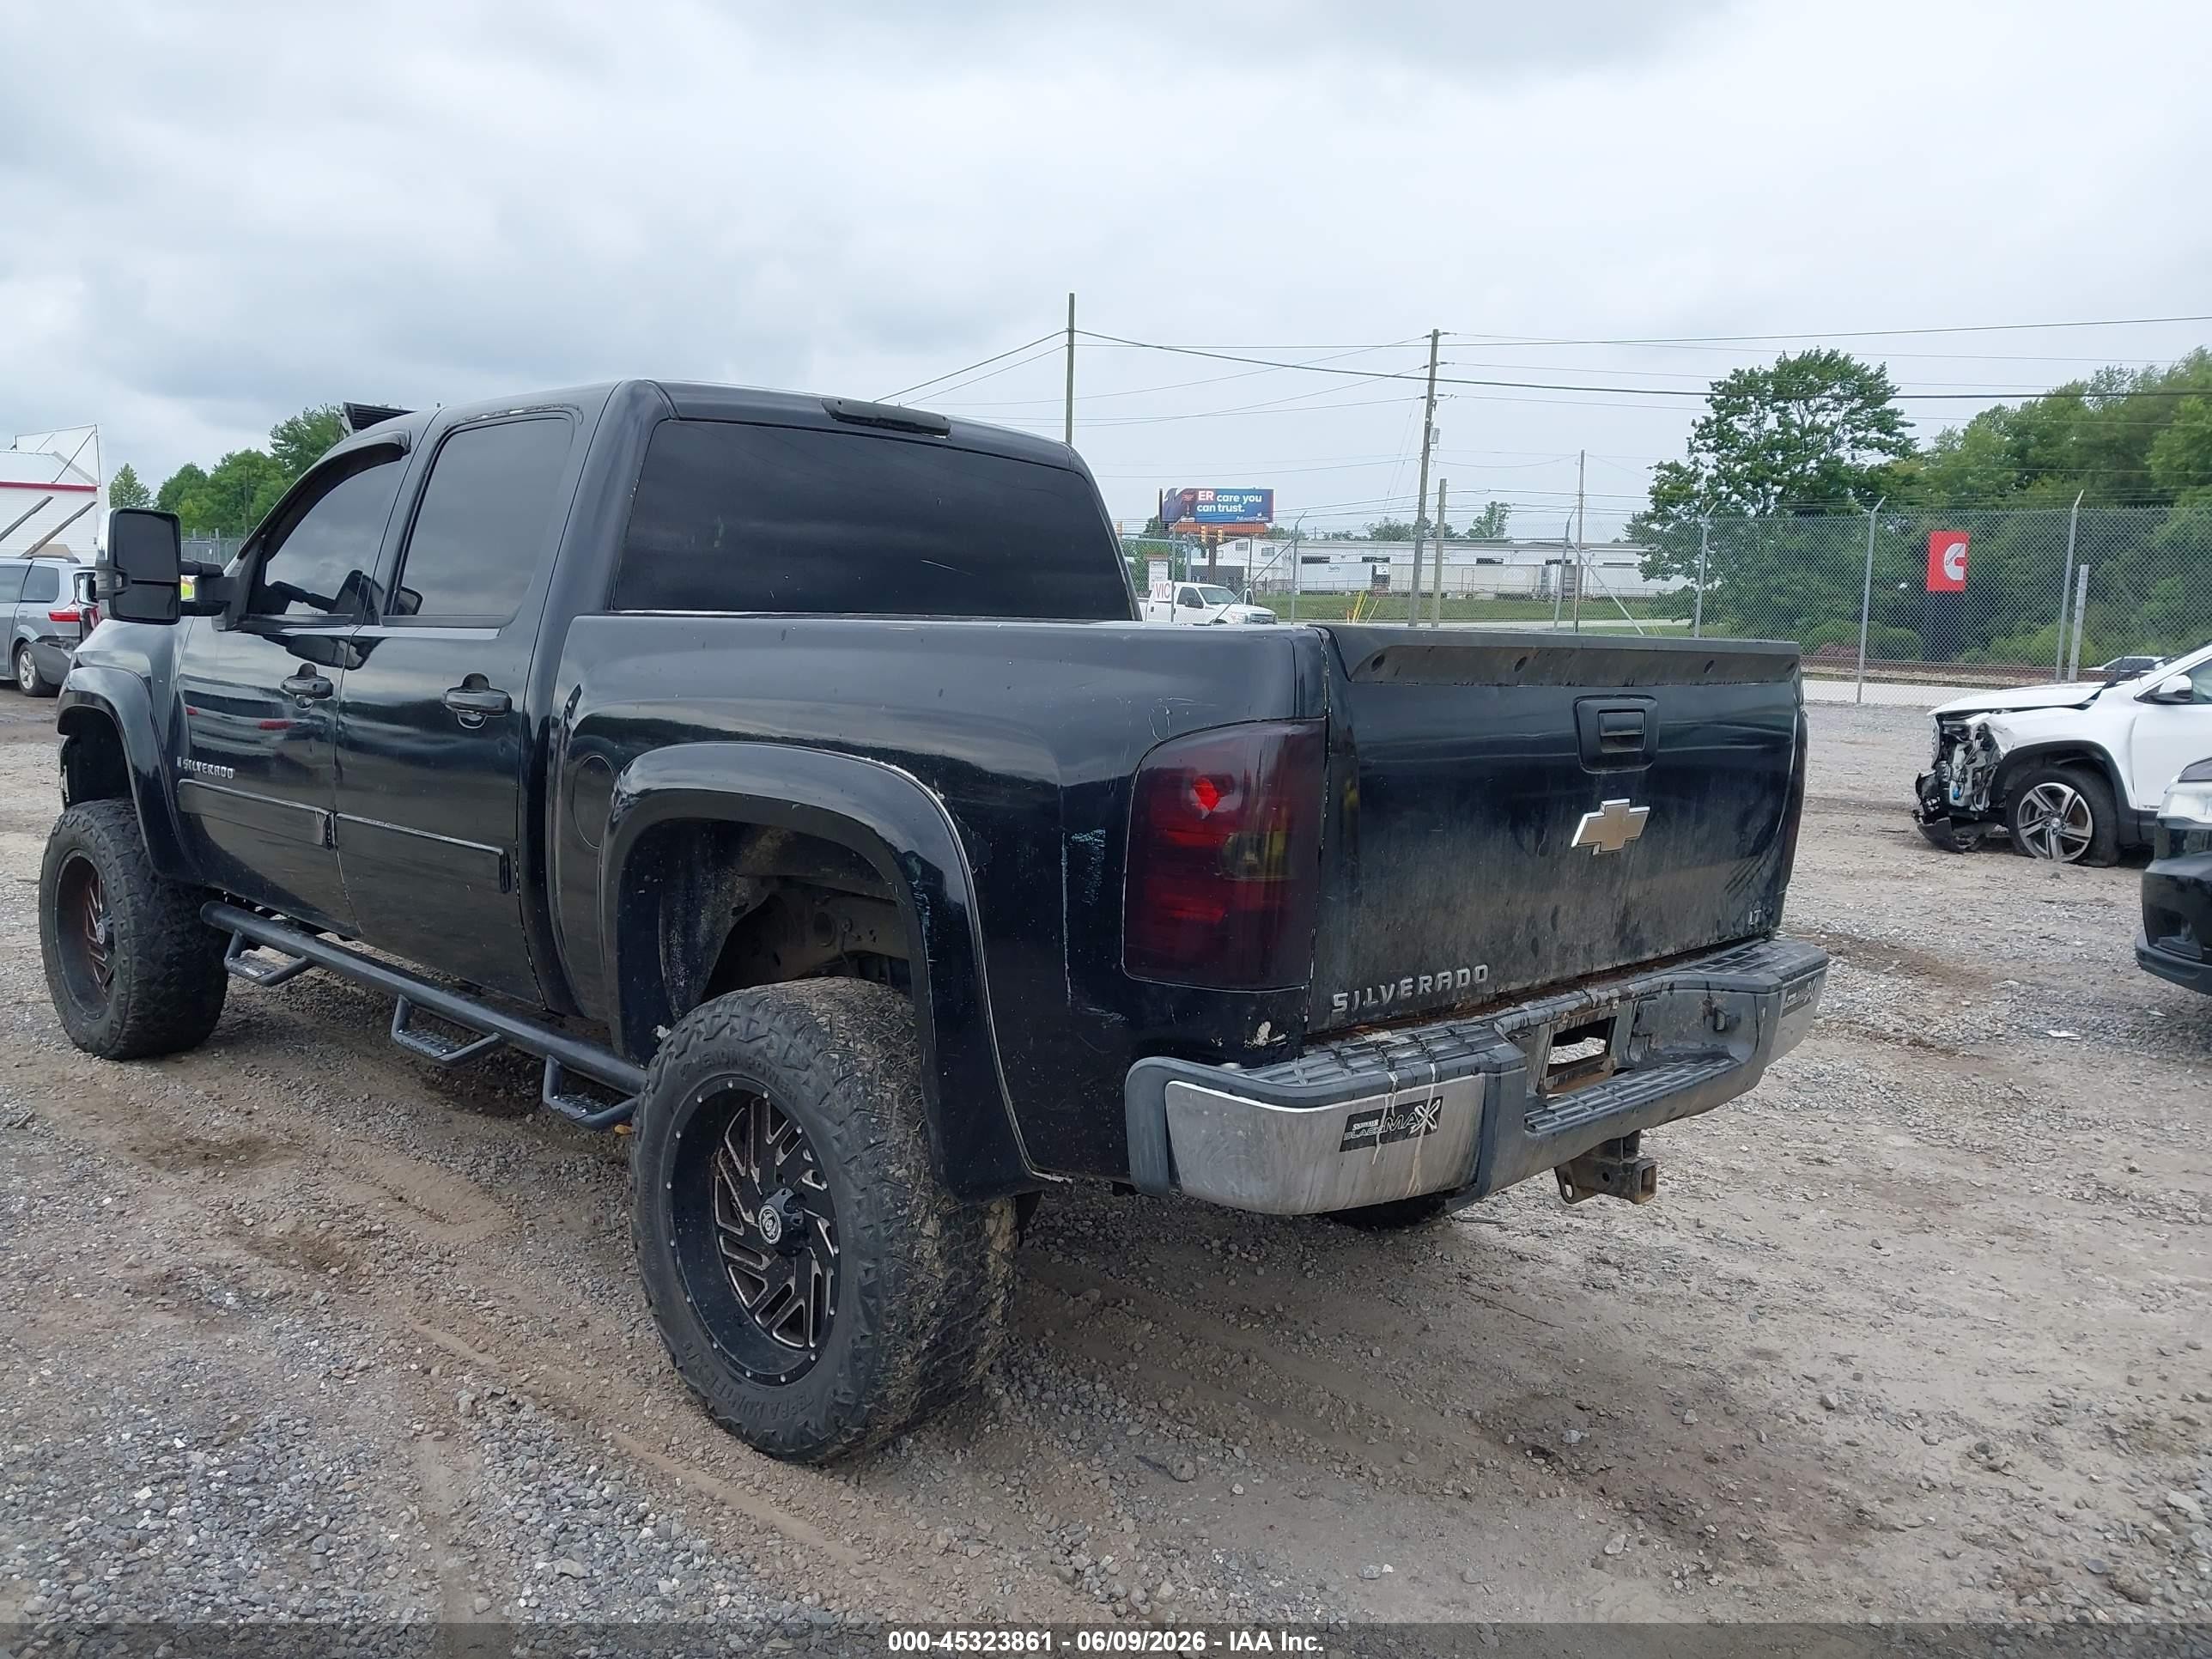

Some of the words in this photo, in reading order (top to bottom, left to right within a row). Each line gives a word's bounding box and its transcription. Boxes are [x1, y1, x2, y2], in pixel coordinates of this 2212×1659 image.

[1198, 490, 1214, 501] ER
[1243, 495, 1262, 504] you
[1218, 504, 1245, 513] trust.
[183, 758, 234, 779] SILVERADO
[1332, 964, 1490, 1014] SILVERADO
